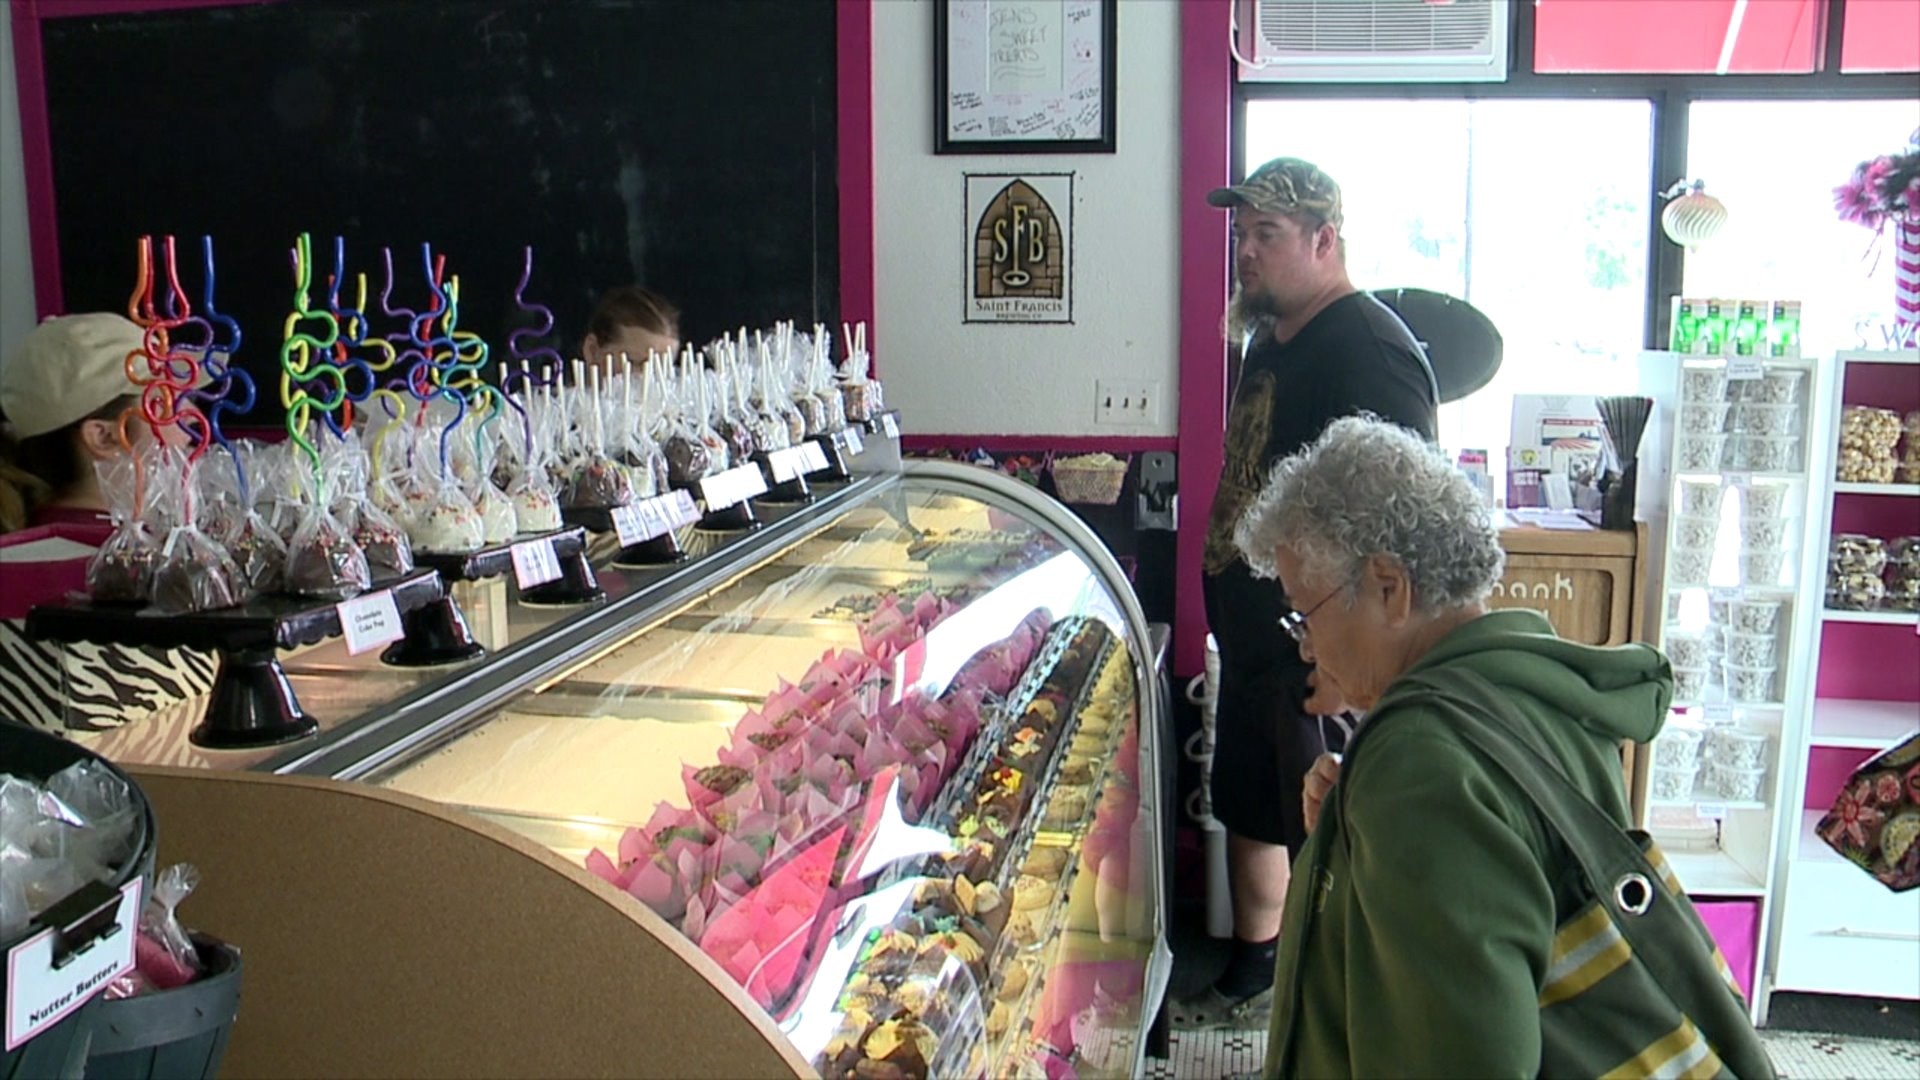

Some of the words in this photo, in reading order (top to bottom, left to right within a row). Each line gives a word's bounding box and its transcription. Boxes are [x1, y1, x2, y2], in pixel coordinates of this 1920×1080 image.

[1000, 25, 1047, 48] SWEET
[991, 49, 1040, 63] TREATS
[994, 204, 1045, 273] SFB
[1488, 572, 1573, 599] hank
[29, 990, 72, 1027] Nutter
[75, 960, 119, 997] Butters
